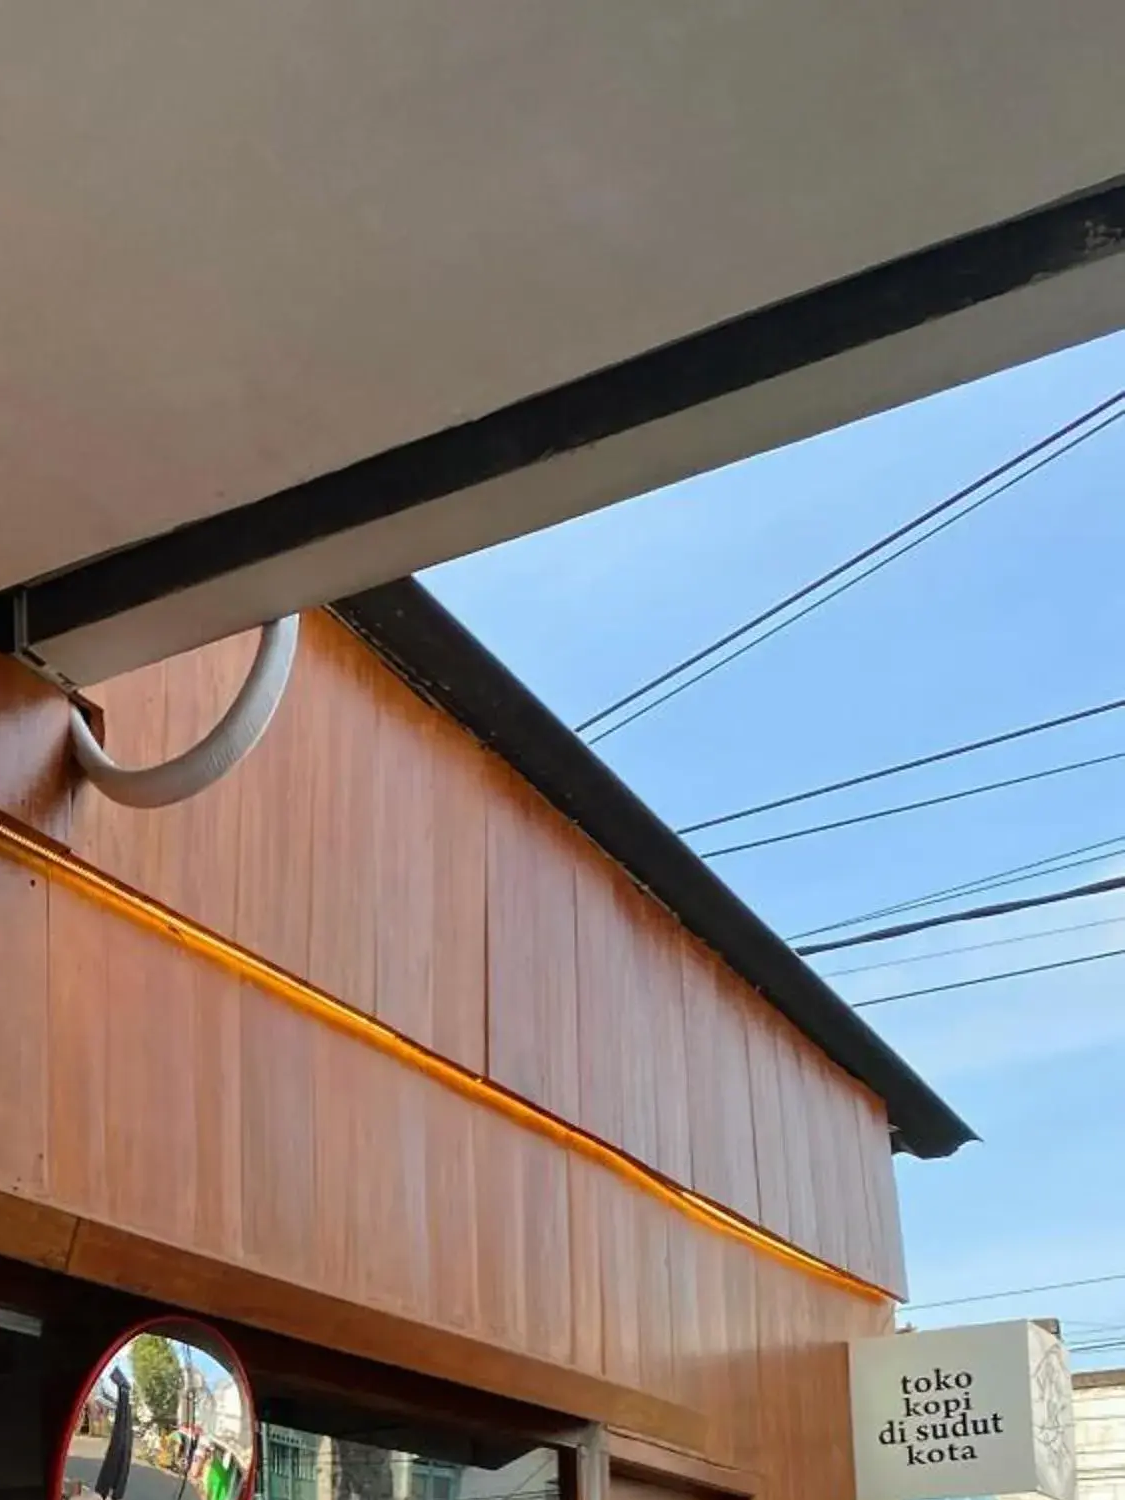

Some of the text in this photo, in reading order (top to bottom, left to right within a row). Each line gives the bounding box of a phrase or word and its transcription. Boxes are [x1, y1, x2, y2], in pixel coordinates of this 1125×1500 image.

[901, 1368, 973, 1395] toko
[904, 1392, 973, 1419] kopi
[879, 1413, 1004, 1446] di sudut
[906, 1443, 978, 1466] kota
